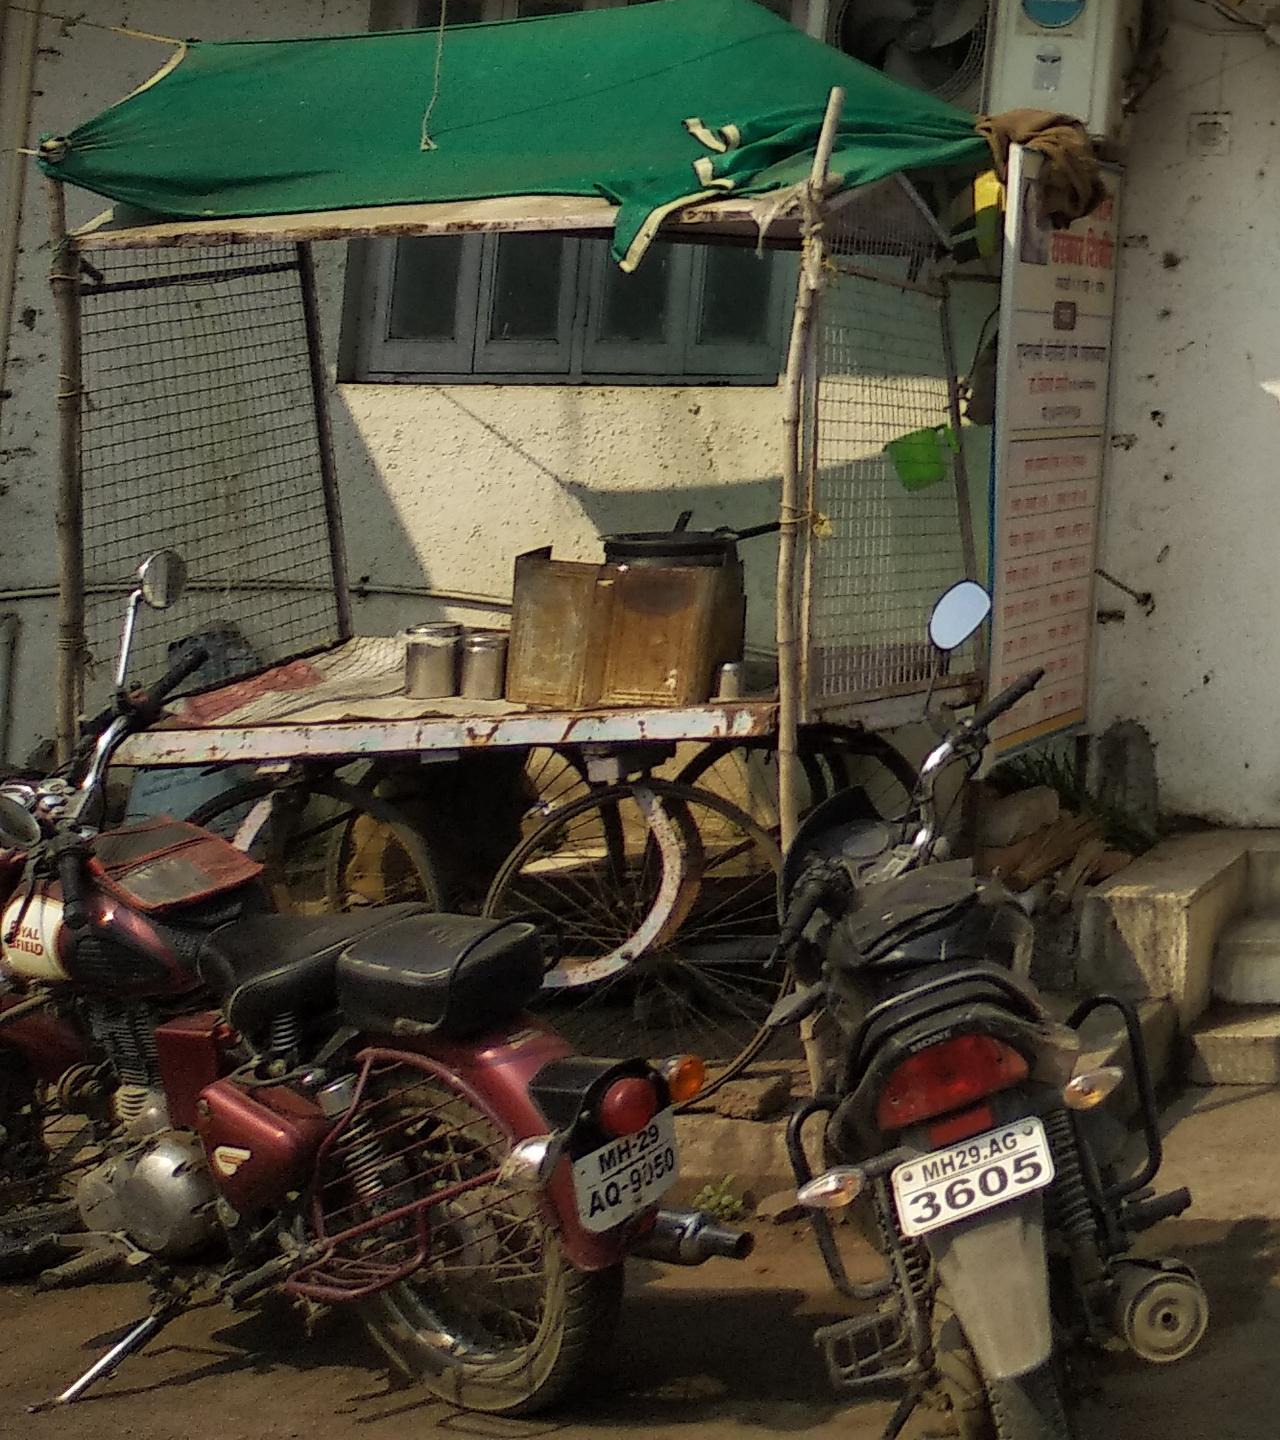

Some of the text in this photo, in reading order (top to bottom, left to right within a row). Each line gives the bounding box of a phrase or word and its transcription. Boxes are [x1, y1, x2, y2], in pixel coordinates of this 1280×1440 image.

[598, 1124, 659, 1174] MH-29
[921, 1132, 1018, 1182] MH29.AG
[589, 1147, 675, 1218] AQ-9050
[909, 1151, 1042, 1224] 3605
